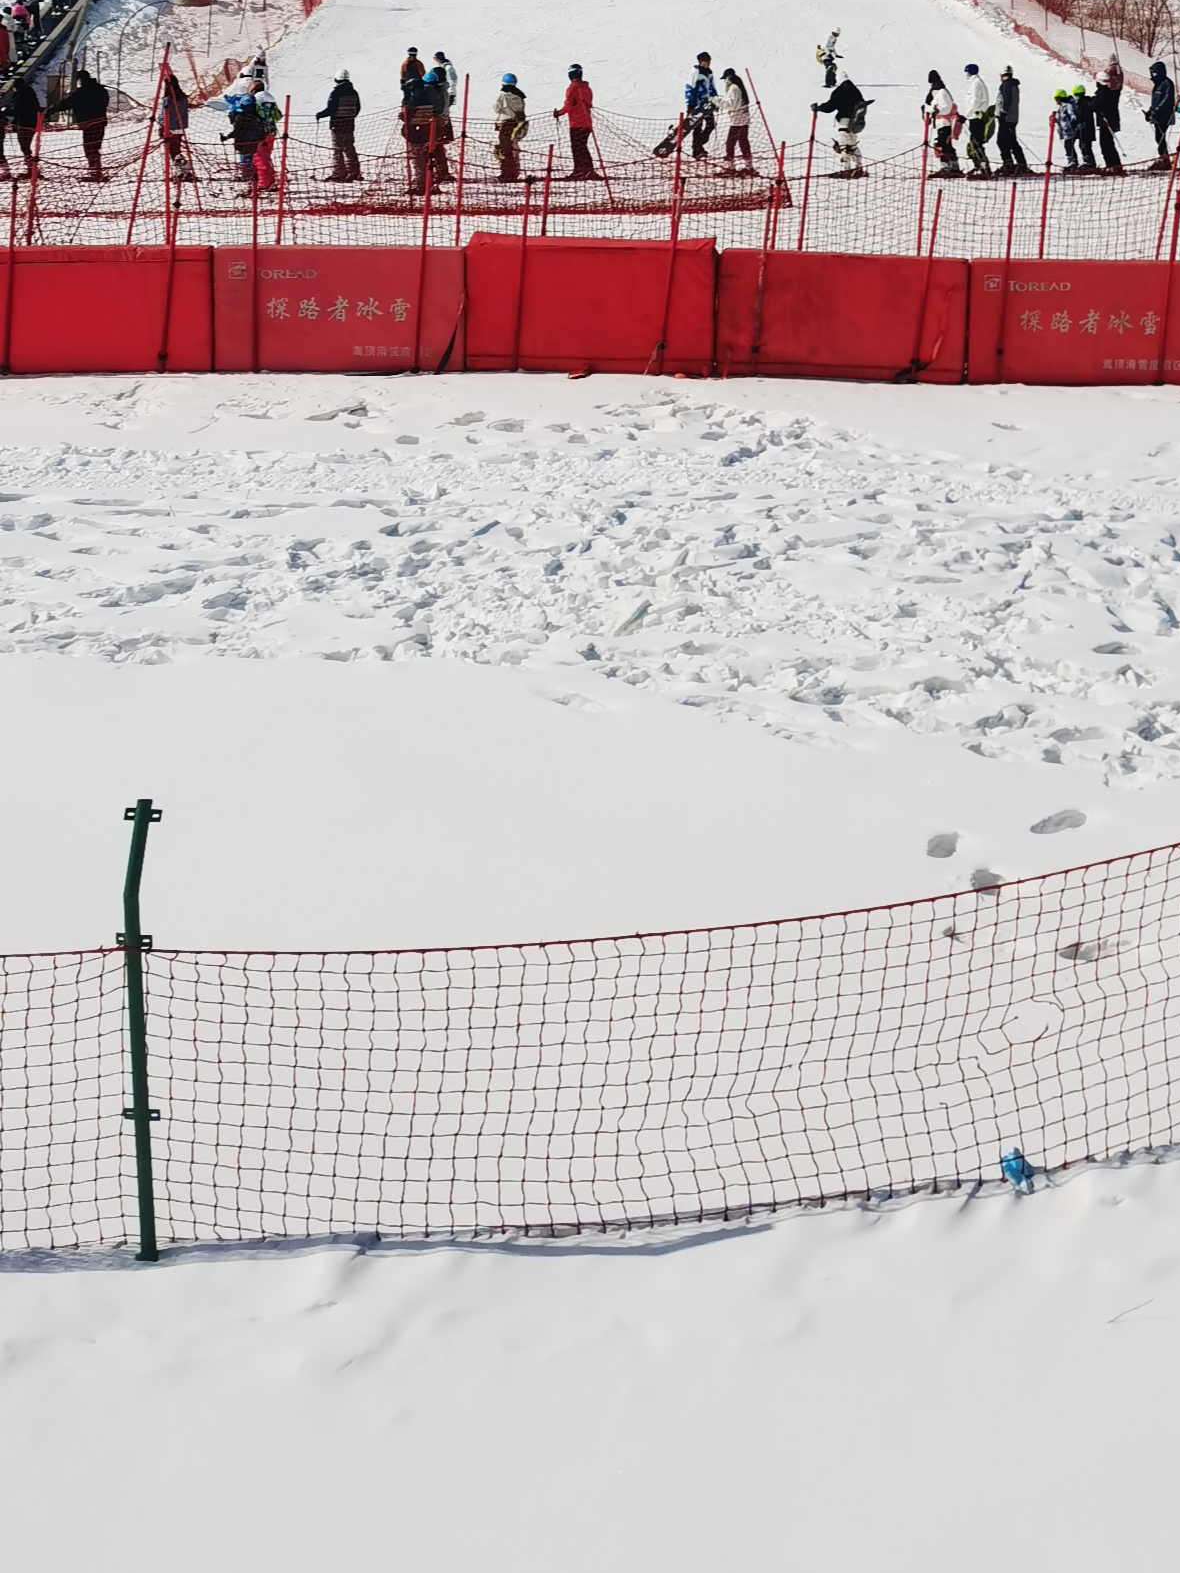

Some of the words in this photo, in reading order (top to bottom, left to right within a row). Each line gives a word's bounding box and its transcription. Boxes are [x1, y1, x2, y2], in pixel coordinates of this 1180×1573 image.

[1008, 280, 1071, 292] TOREAD
[266, 295, 411, 322] 探路者冰雪
[1020, 308, 1161, 335] 探路者冰雪
